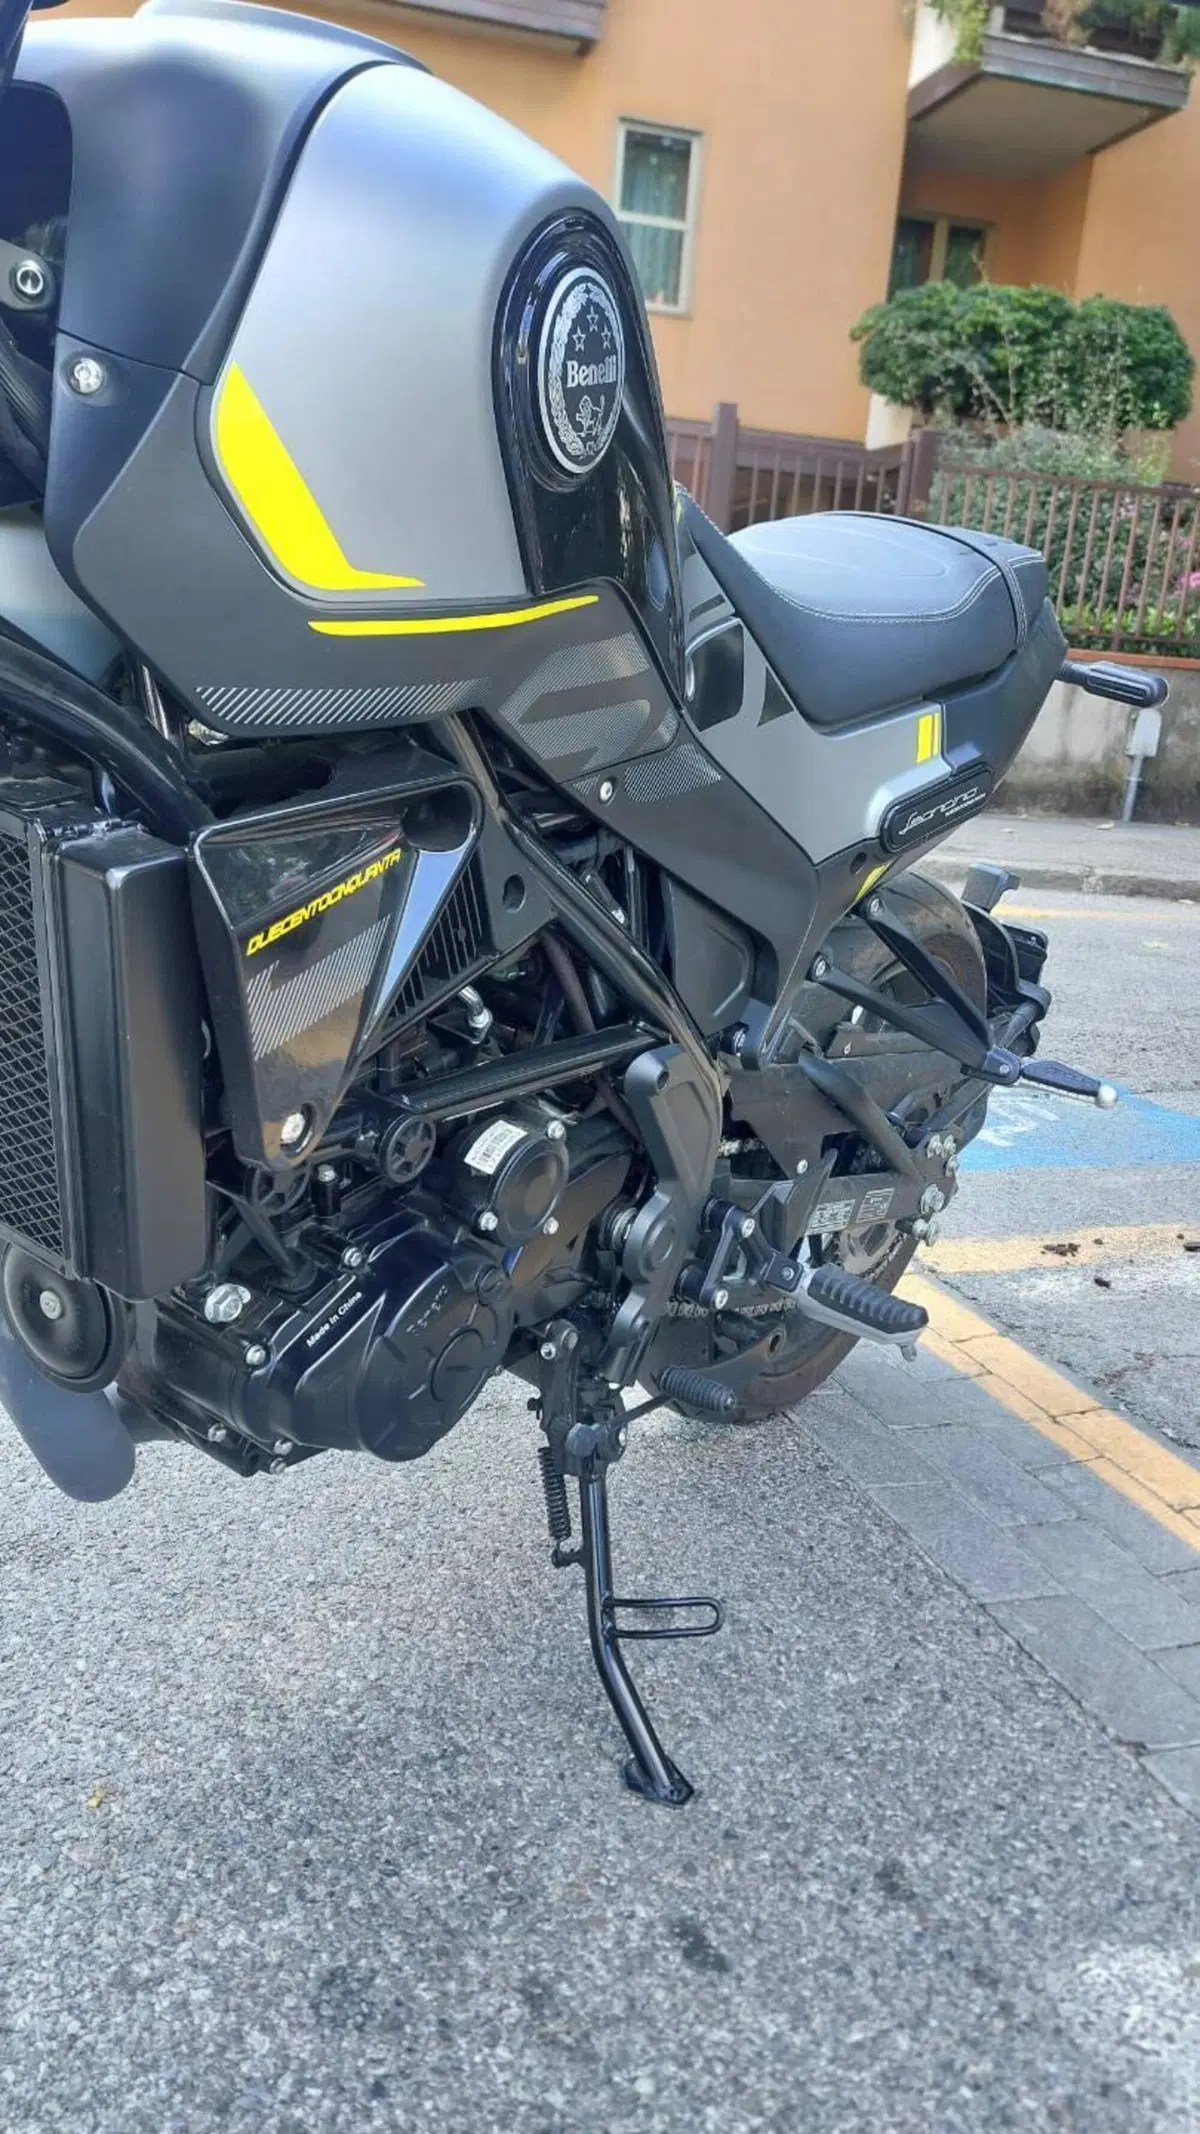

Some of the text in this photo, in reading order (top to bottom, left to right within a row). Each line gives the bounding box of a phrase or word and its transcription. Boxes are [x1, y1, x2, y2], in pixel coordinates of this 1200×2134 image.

[566, 354, 617, 388] Benelli
[305, 1323, 331, 1348] Made
[337, 1291, 363, 1317] China
